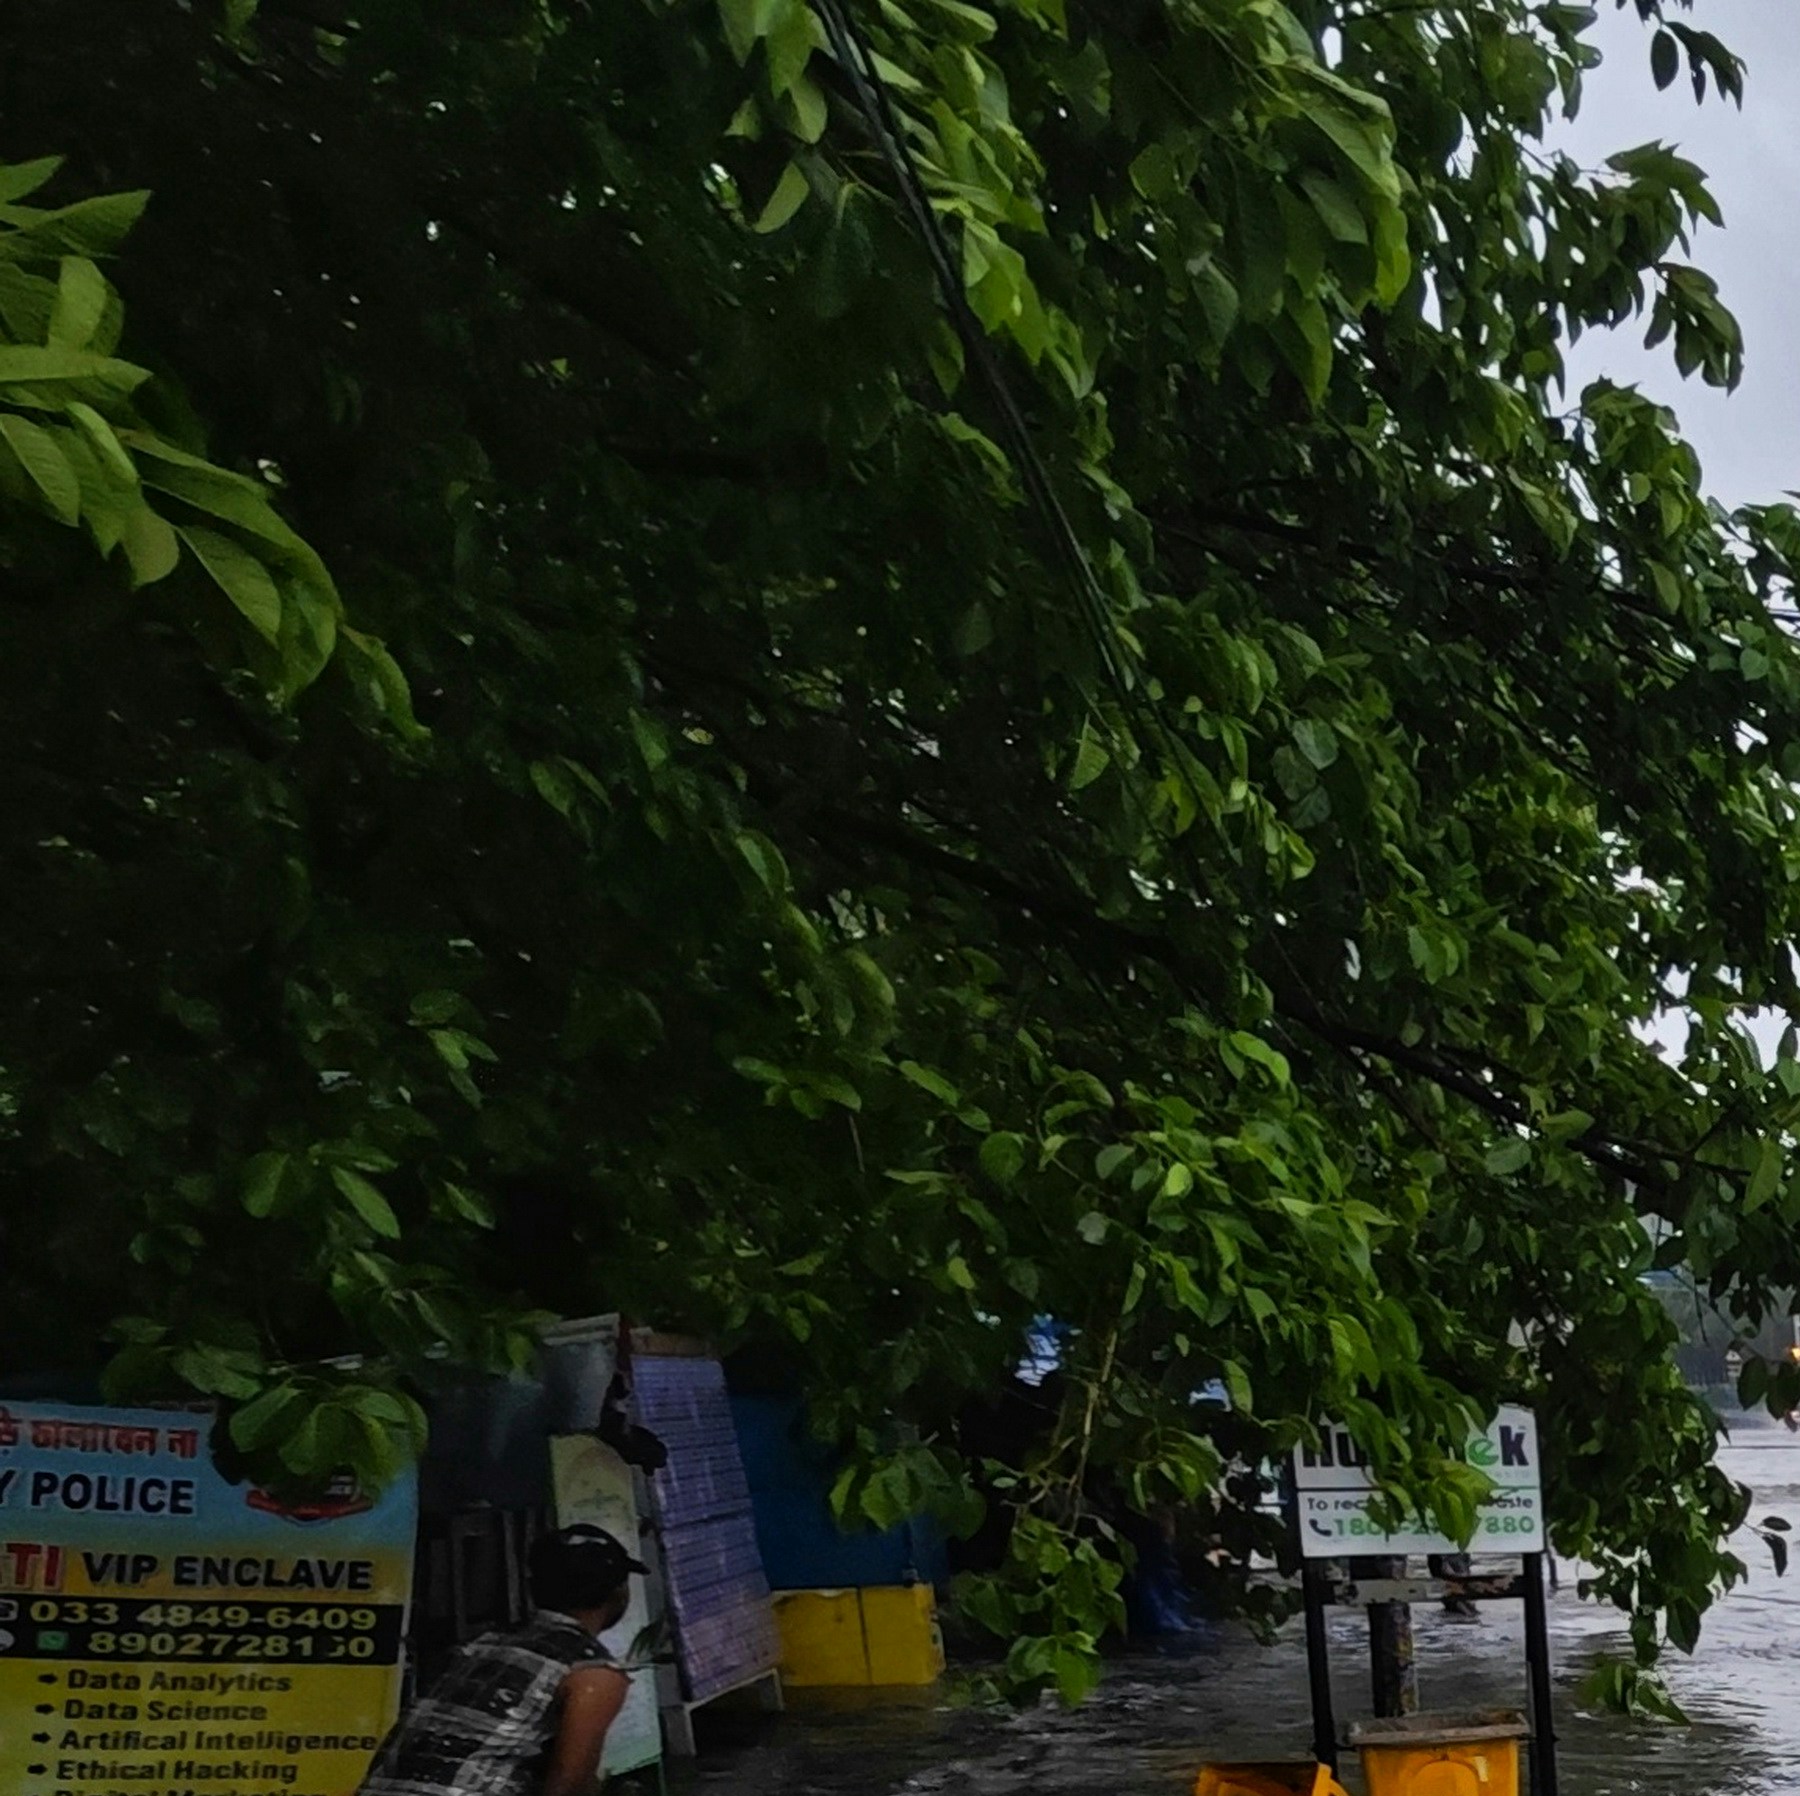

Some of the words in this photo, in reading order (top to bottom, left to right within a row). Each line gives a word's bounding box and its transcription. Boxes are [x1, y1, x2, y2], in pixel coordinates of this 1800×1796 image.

[31, 1471, 195, 1515] POLICE
[1307, 1497, 1328, 1511] To
[82, 1552, 158, 1586] VIP
[173, 1556, 374, 1589] ENCLAVE
[30, 1600, 119, 1625] 033
[136, 1604, 377, 1630] 4849-6409
[67, 1669, 141, 1692] Data
[149, 1671, 292, 1696] Analytics
[64, 1699, 138, 1721] Data
[147, 1701, 268, 1722] Science
[195, 1731, 377, 1754] Intelligence
[56, 1759, 164, 1780] Ethical
[173, 1760, 298, 1784] Hacking
